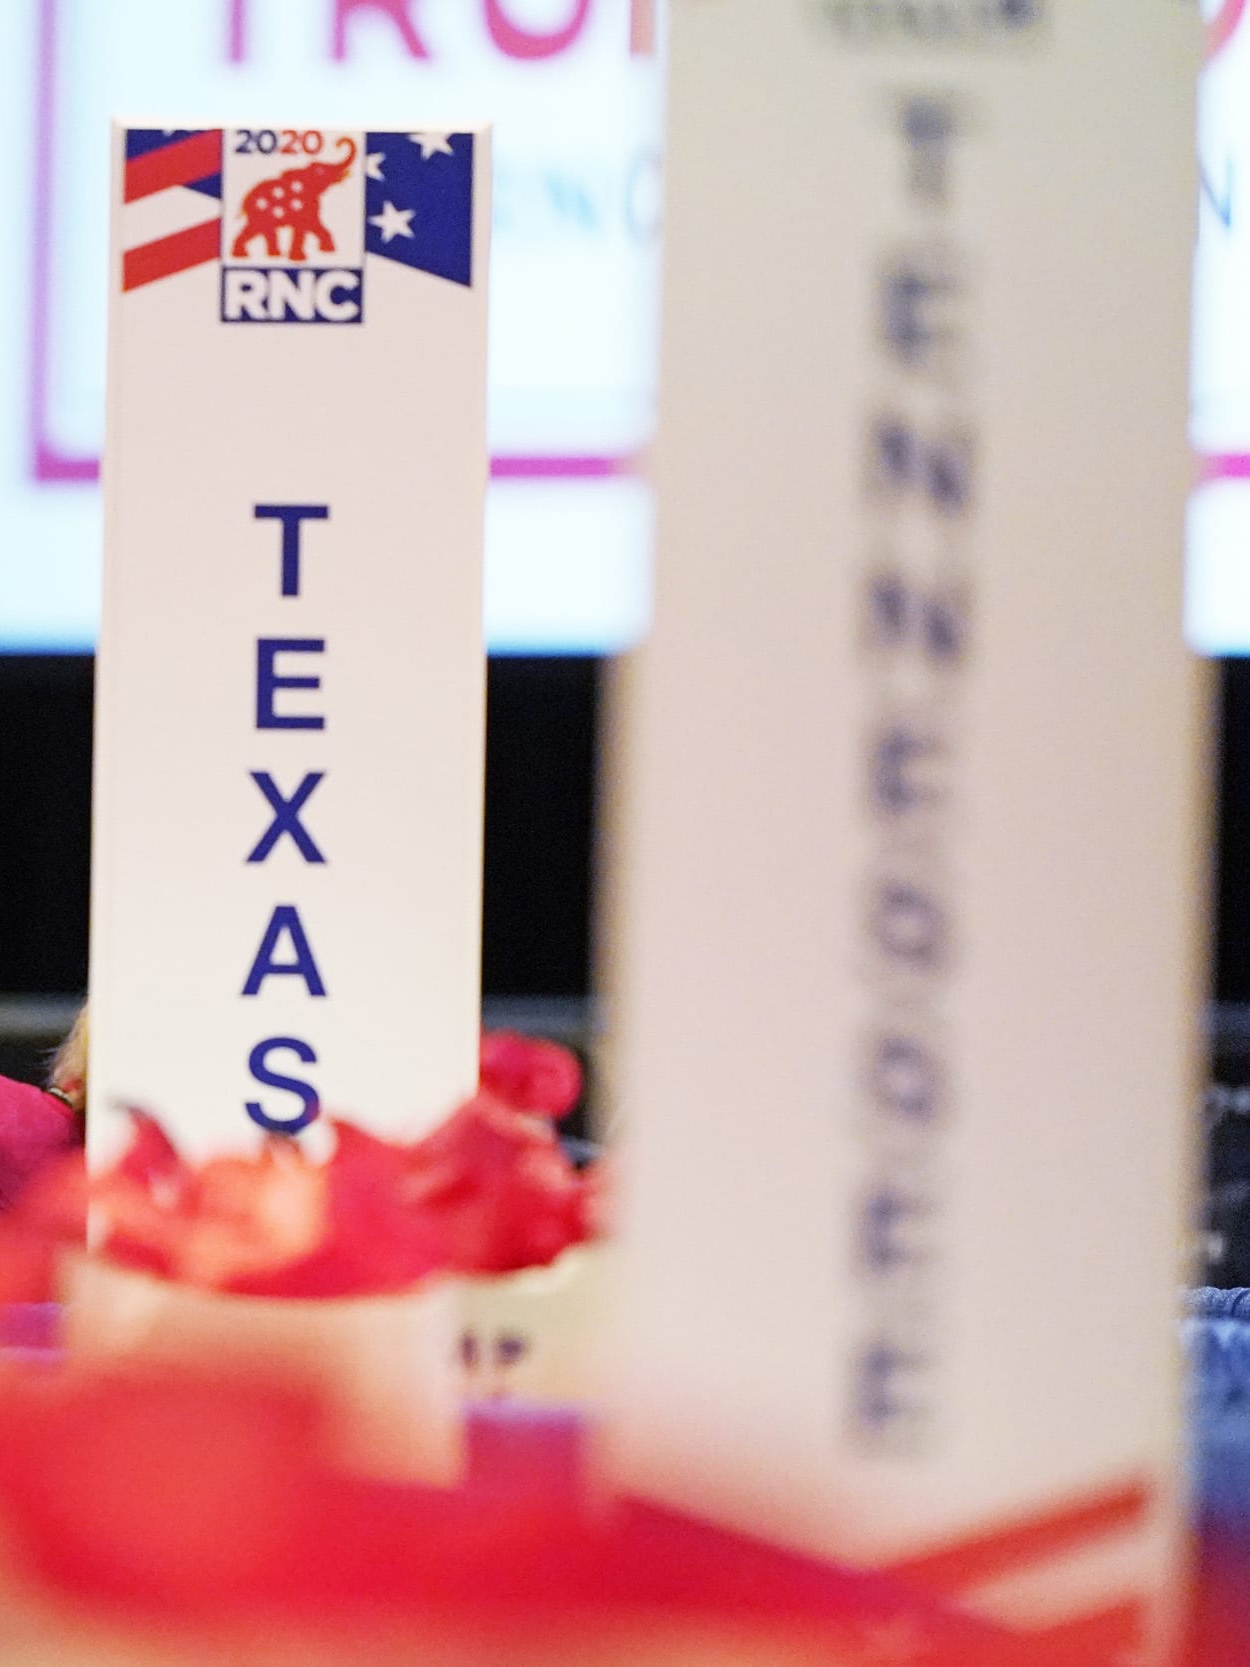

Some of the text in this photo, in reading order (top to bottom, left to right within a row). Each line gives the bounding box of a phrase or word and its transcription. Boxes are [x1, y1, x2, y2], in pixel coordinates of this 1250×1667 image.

[234, 130, 325, 154] 2020
[224, 270, 360, 322] RNC
[241, 504, 329, 1137] TEXAS
